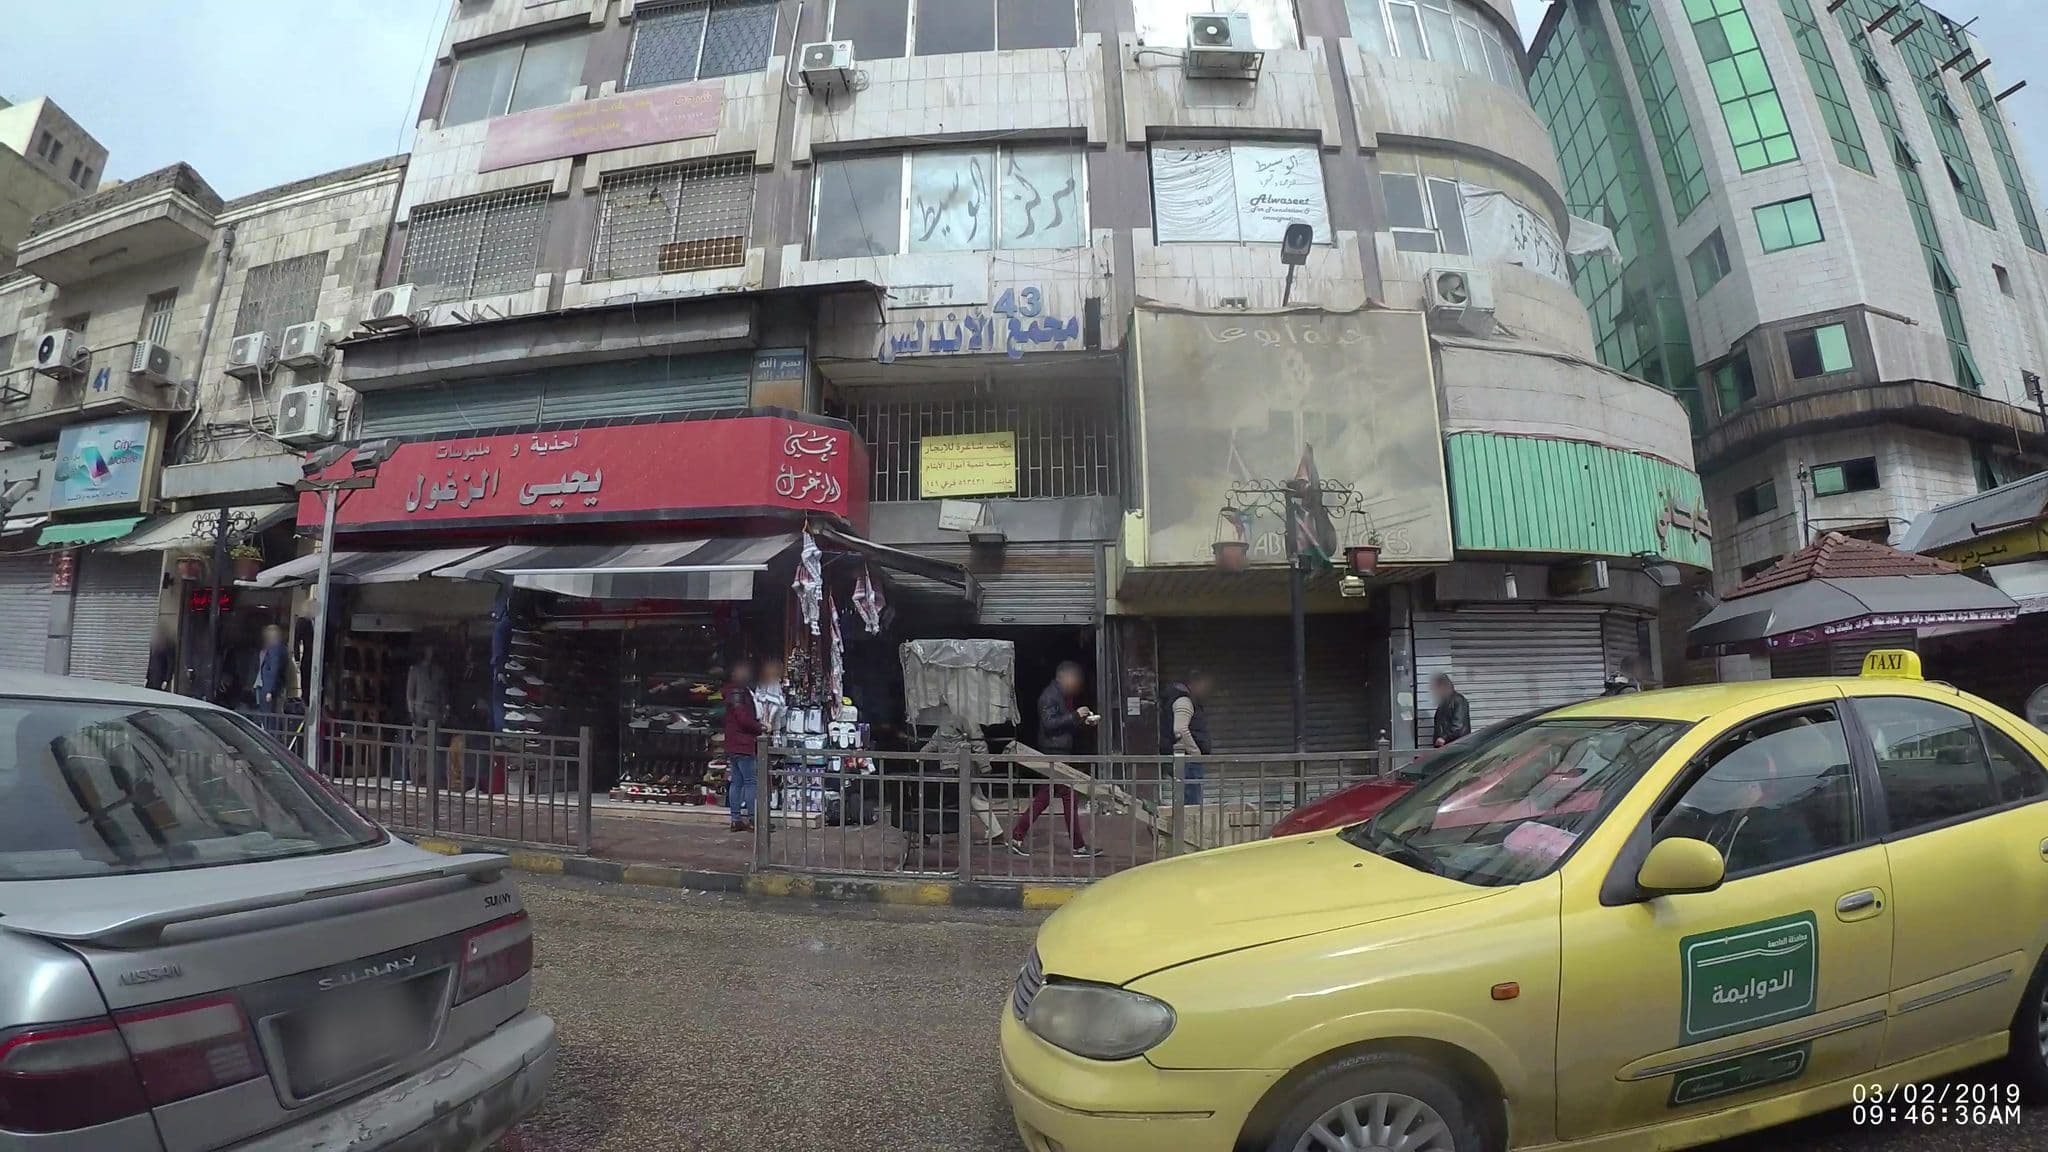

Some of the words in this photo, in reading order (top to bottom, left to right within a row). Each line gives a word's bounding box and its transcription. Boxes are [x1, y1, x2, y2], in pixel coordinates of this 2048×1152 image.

[993, 286, 1043, 319] 43
[1006, 316, 1080, 360] مجمع
[758, 355, 777, 369] الله
[93, 367, 111, 392] 41
[113, 440, 133, 452] City
[510, 442, 520, 457] و
[530, 432, 579, 457] أحذية
[405, 466, 502, 513] الزغول
[1869, 654, 1903, 670] TAXI
[484, 892, 512, 909] SUNNY
[119, 961, 184, 987] NISSAN
[319, 953, 418, 992] SUNNY
[1711, 968, 1794, 1005] الدوايمة
